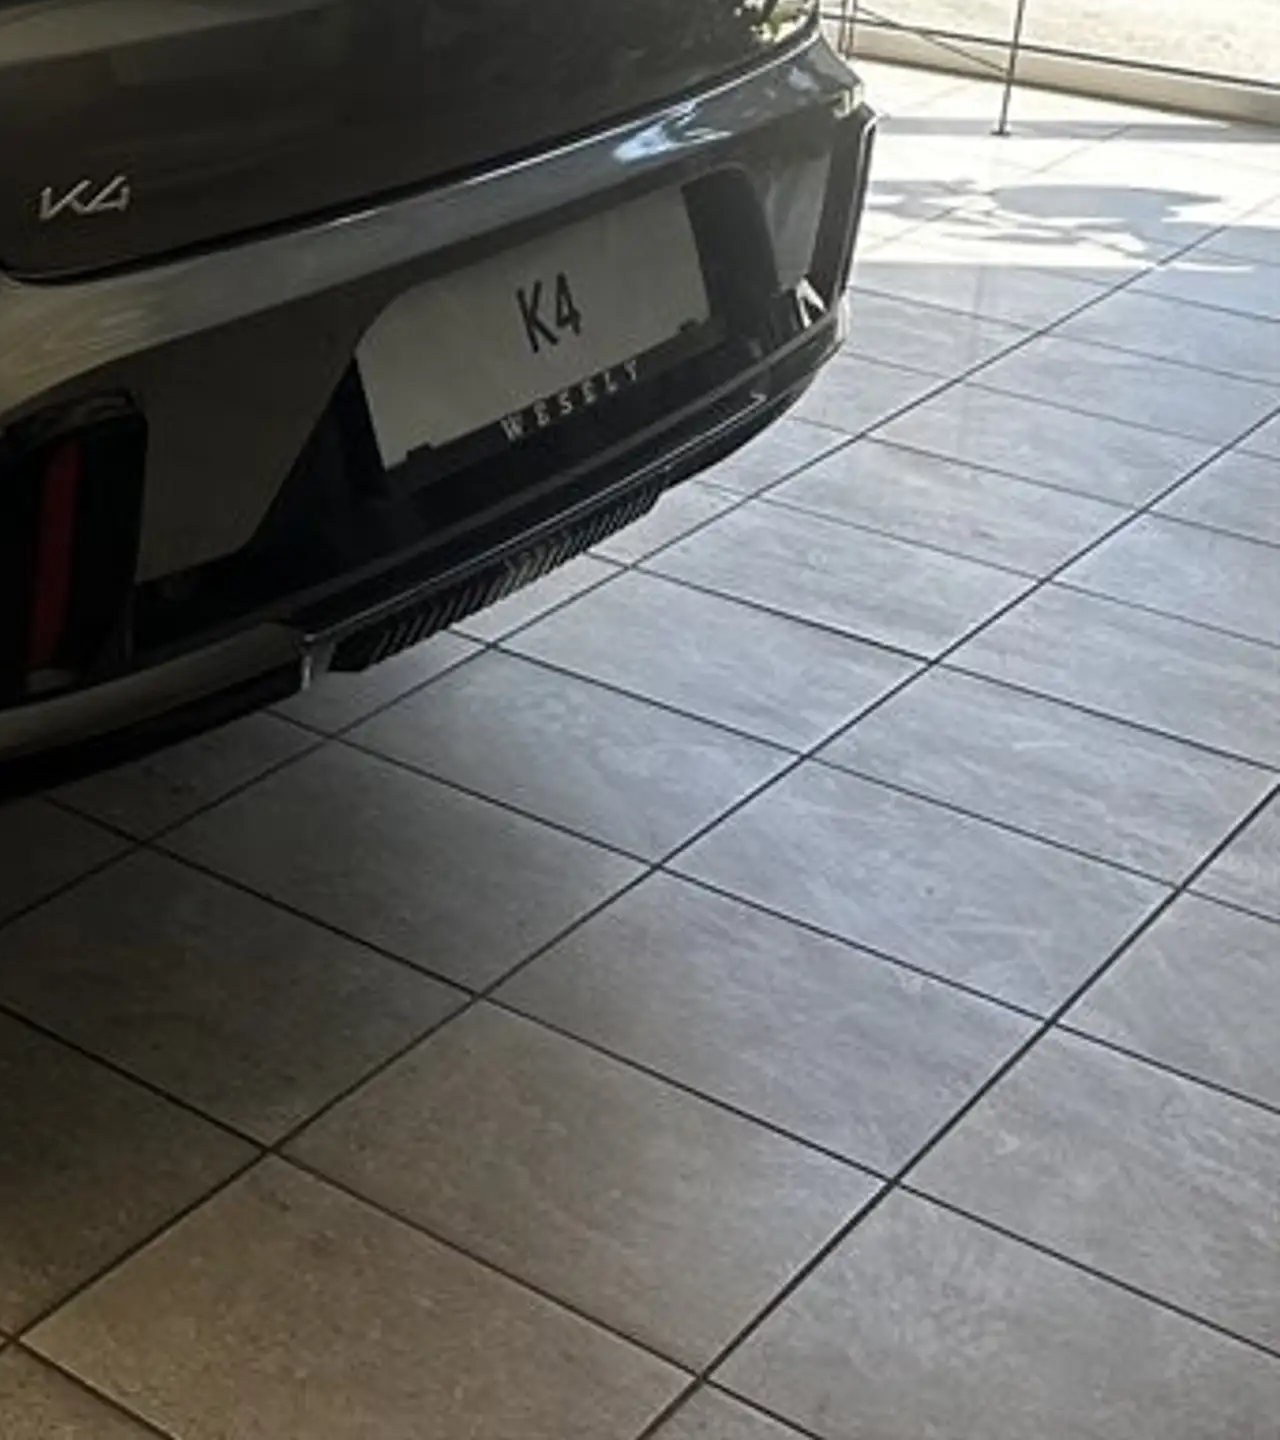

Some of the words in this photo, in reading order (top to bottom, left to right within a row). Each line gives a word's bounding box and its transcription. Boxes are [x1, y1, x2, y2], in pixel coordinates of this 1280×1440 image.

[39, 175, 130, 220] K4
[517, 271, 581, 353] K4
[500, 359, 637, 441] WESELY
